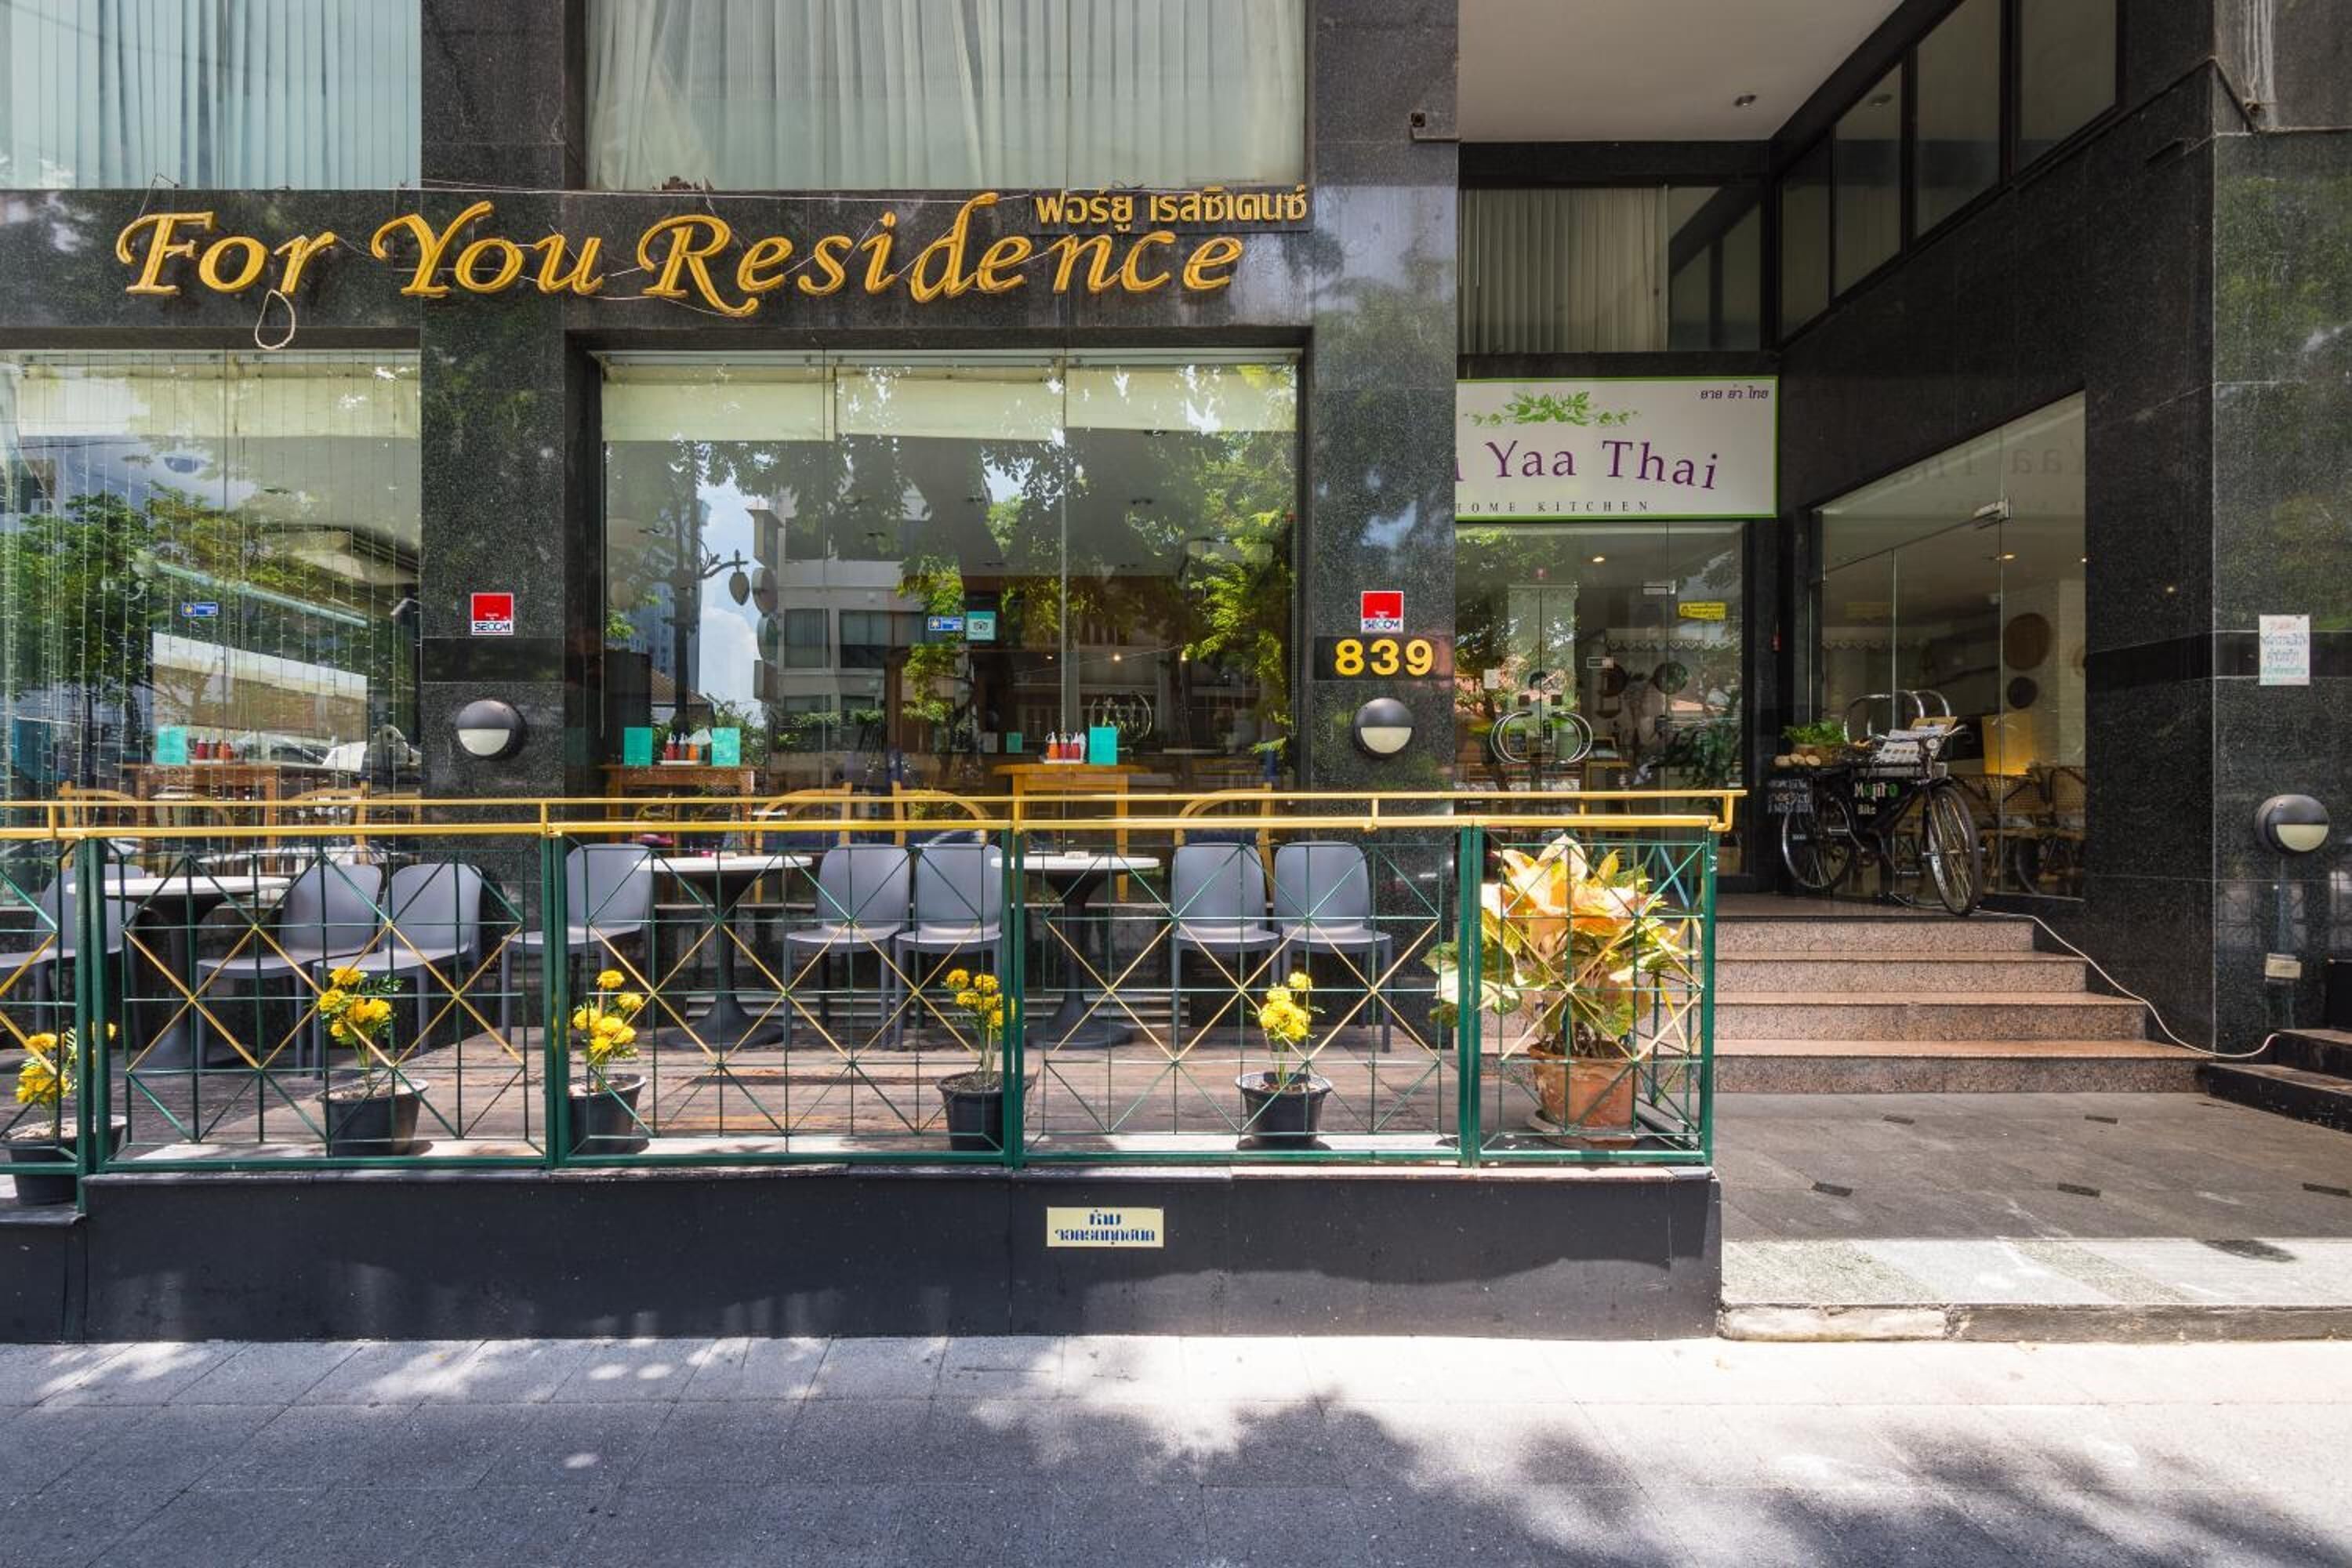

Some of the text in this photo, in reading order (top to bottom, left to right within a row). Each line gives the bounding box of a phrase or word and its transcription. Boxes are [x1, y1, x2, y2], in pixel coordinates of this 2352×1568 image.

[1035, 184, 1307, 232] ฟอร์ยู เรสซิเดนซ์
[114, 191, 1244, 318] For You Residence
[1484, 440, 1577, 478] Yaa
[1602, 440, 1719, 490] Thai
[1537, 501, 1650, 512] KITCHEN
[474, 622, 510, 631] SECOM
[1335, 639, 1433, 676] 839
